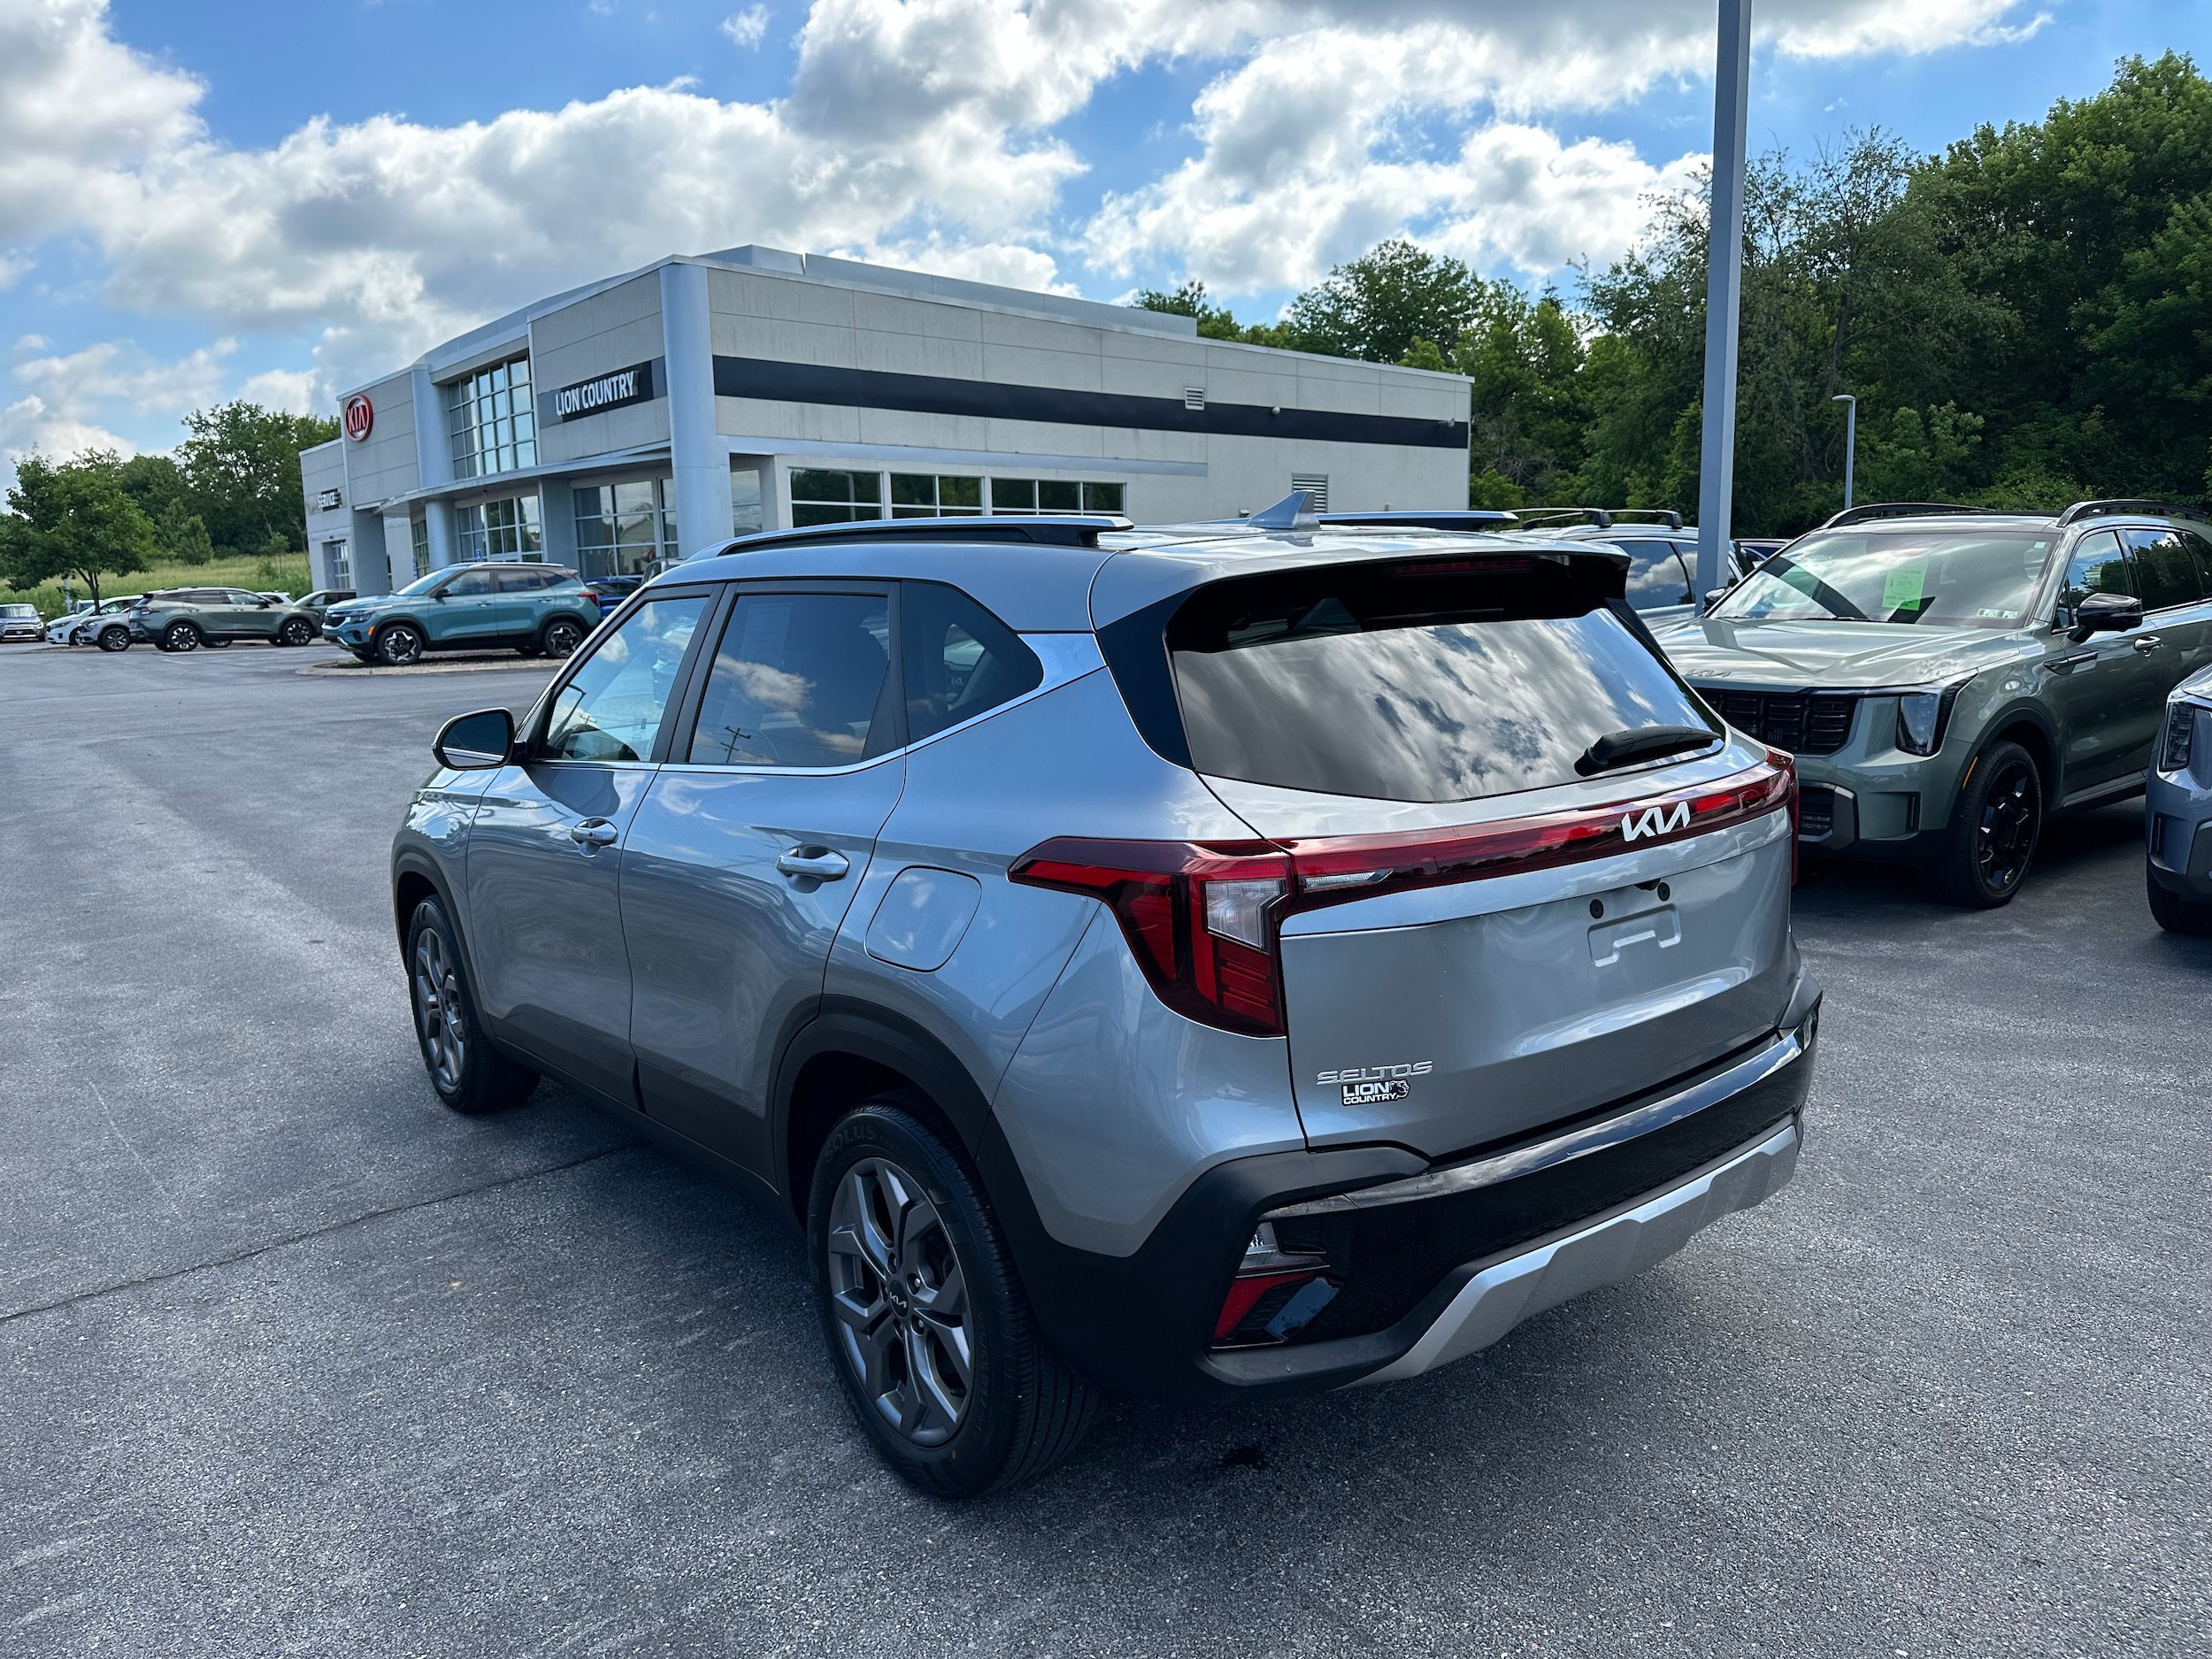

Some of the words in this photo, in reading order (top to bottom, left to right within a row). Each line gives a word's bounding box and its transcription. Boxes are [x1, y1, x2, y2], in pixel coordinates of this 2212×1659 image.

[555, 388, 580, 416] LION
[581, 371, 634, 409] COUNTRY
[347, 405, 366, 433] KIA
[319, 492, 335, 508] SERVICE
[1621, 801, 1690, 841] KIA
[1317, 1061, 1432, 1085] SELTOS
[1342, 1082, 1389, 1097] LION
[1343, 1093, 1397, 1105] COUNTRY
[825, 1125, 877, 1163] SOLUS
